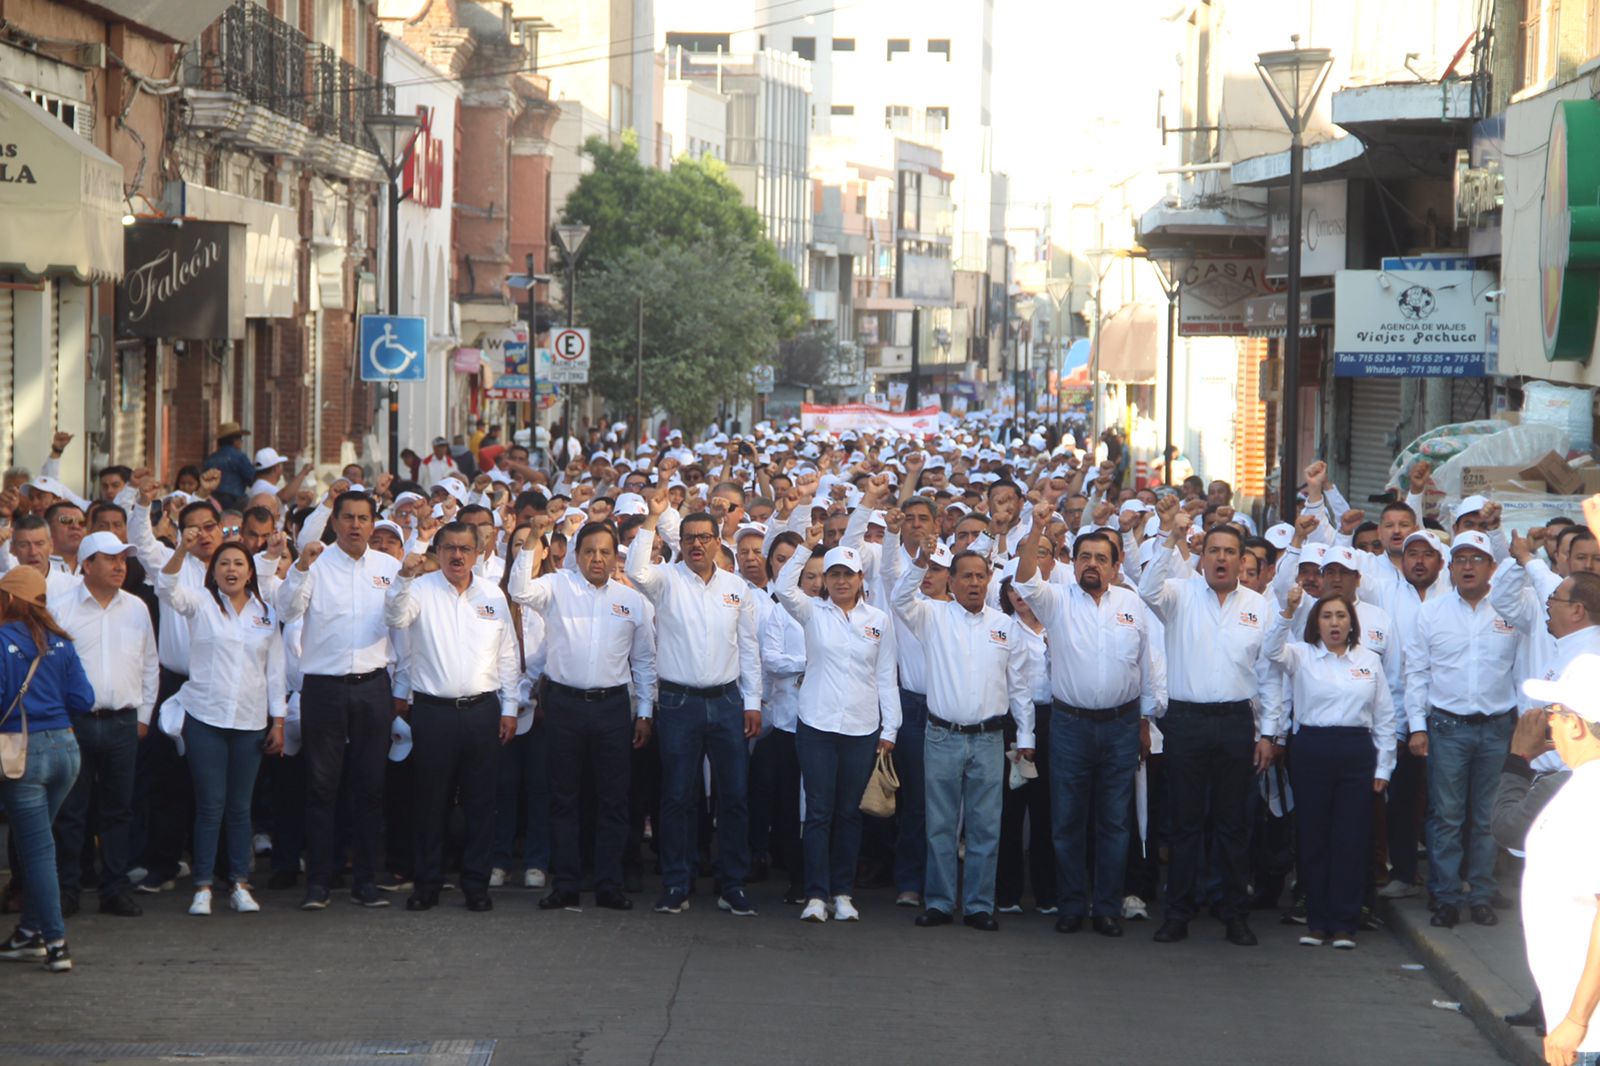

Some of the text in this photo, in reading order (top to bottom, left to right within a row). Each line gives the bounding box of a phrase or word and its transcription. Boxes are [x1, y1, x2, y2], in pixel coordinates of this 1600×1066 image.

[0, 143, 17, 158] s
[127, 238, 221, 322] Falcón
[1184, 262, 1257, 288] CASA
[1380, 323, 1467, 331] AGENCIA DE VIAJES
[1357, 331, 1477, 345] Viajes Pachuca
[565, 335, 576, 355] E
[1358, 354, 1374, 363] 715
[1365, 365, 1409, 375] WhatsApp:
[1411, 365, 1425, 374] 771
[381, 576, 390, 585] 15
[731, 593, 740, 602] 15
[485, 605, 494, 614] 15
[621, 605, 630, 614] 15
[1124, 613, 1133, 622] 15
[1248, 612, 1257, 622] 15
[872, 627, 880, 637] 15
[998, 630, 1007, 640] 15
